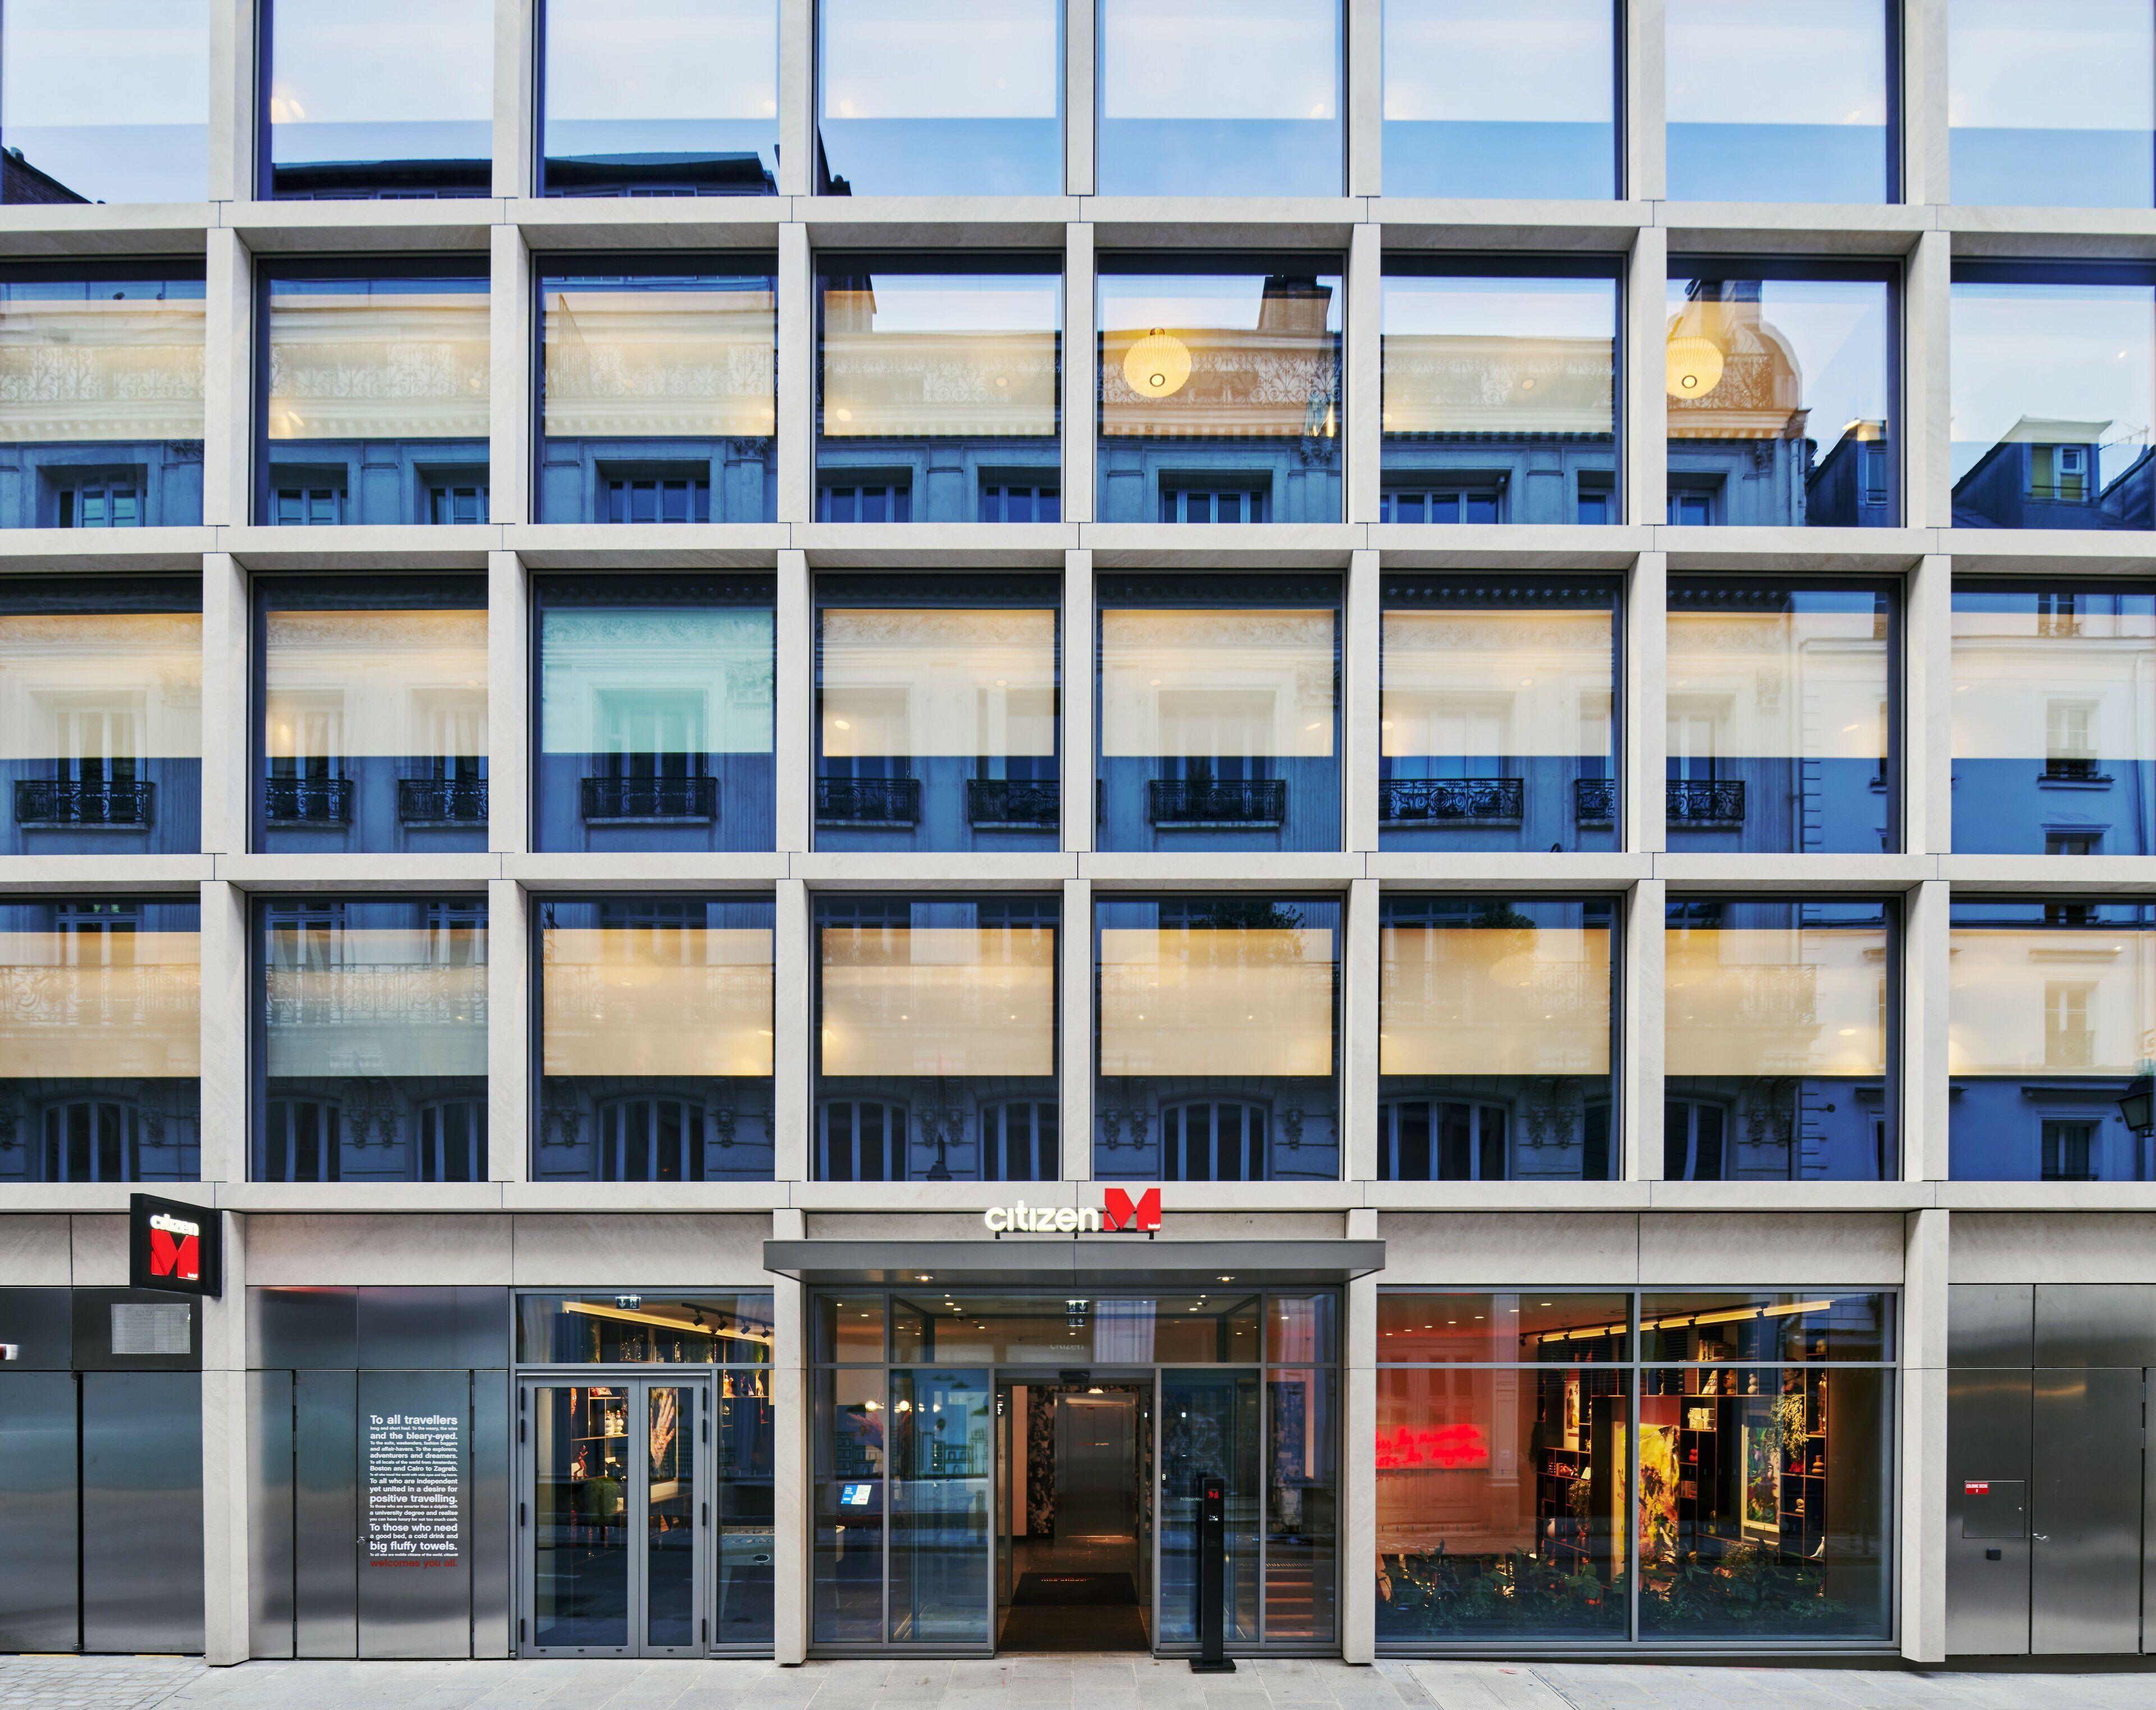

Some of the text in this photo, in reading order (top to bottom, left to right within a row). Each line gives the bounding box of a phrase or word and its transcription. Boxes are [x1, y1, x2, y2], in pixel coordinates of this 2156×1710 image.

[150, 1214, 199, 1236] citizen
[370, 1415, 458, 1425] To all travellers
[406, 1432, 458, 1441] bleary-eyed.
[369, 1494, 457, 1505] positive travelling.
[371, 1541, 457, 1552] big fluffy towels.
[424, 1560, 441, 1569] you
